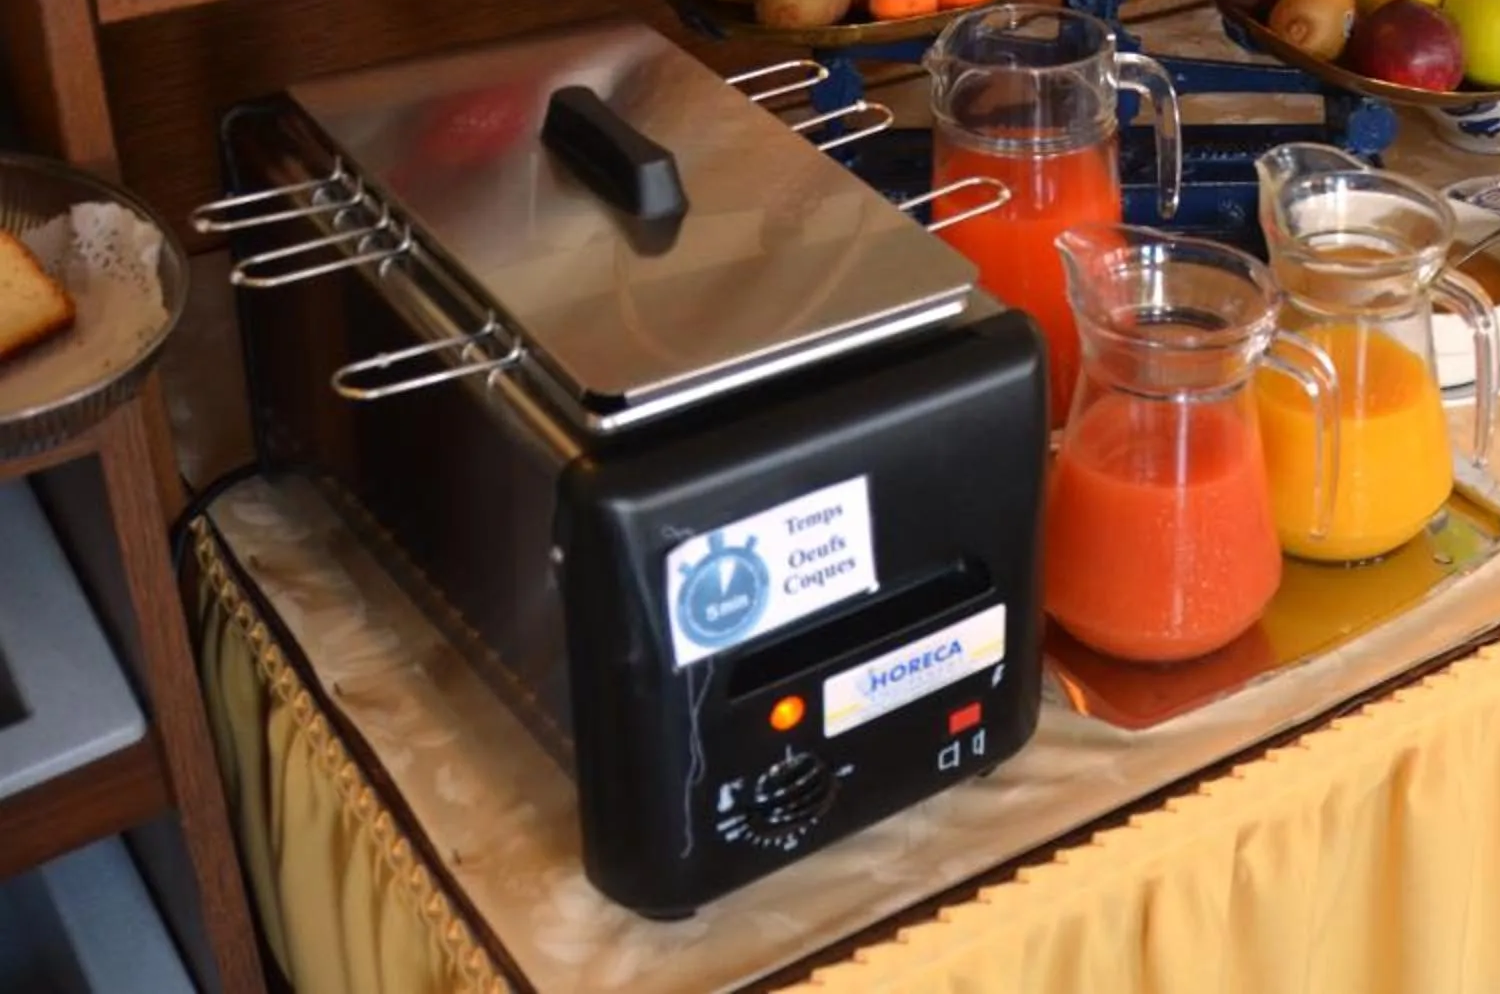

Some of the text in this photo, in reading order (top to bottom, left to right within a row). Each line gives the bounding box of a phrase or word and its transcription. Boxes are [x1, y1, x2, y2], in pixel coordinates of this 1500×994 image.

[785, 503, 844, 535] Temps
[787, 534, 847, 569] Oeufs
[783, 555, 857, 595] Coques
[870, 639, 963, 692] HORECA
